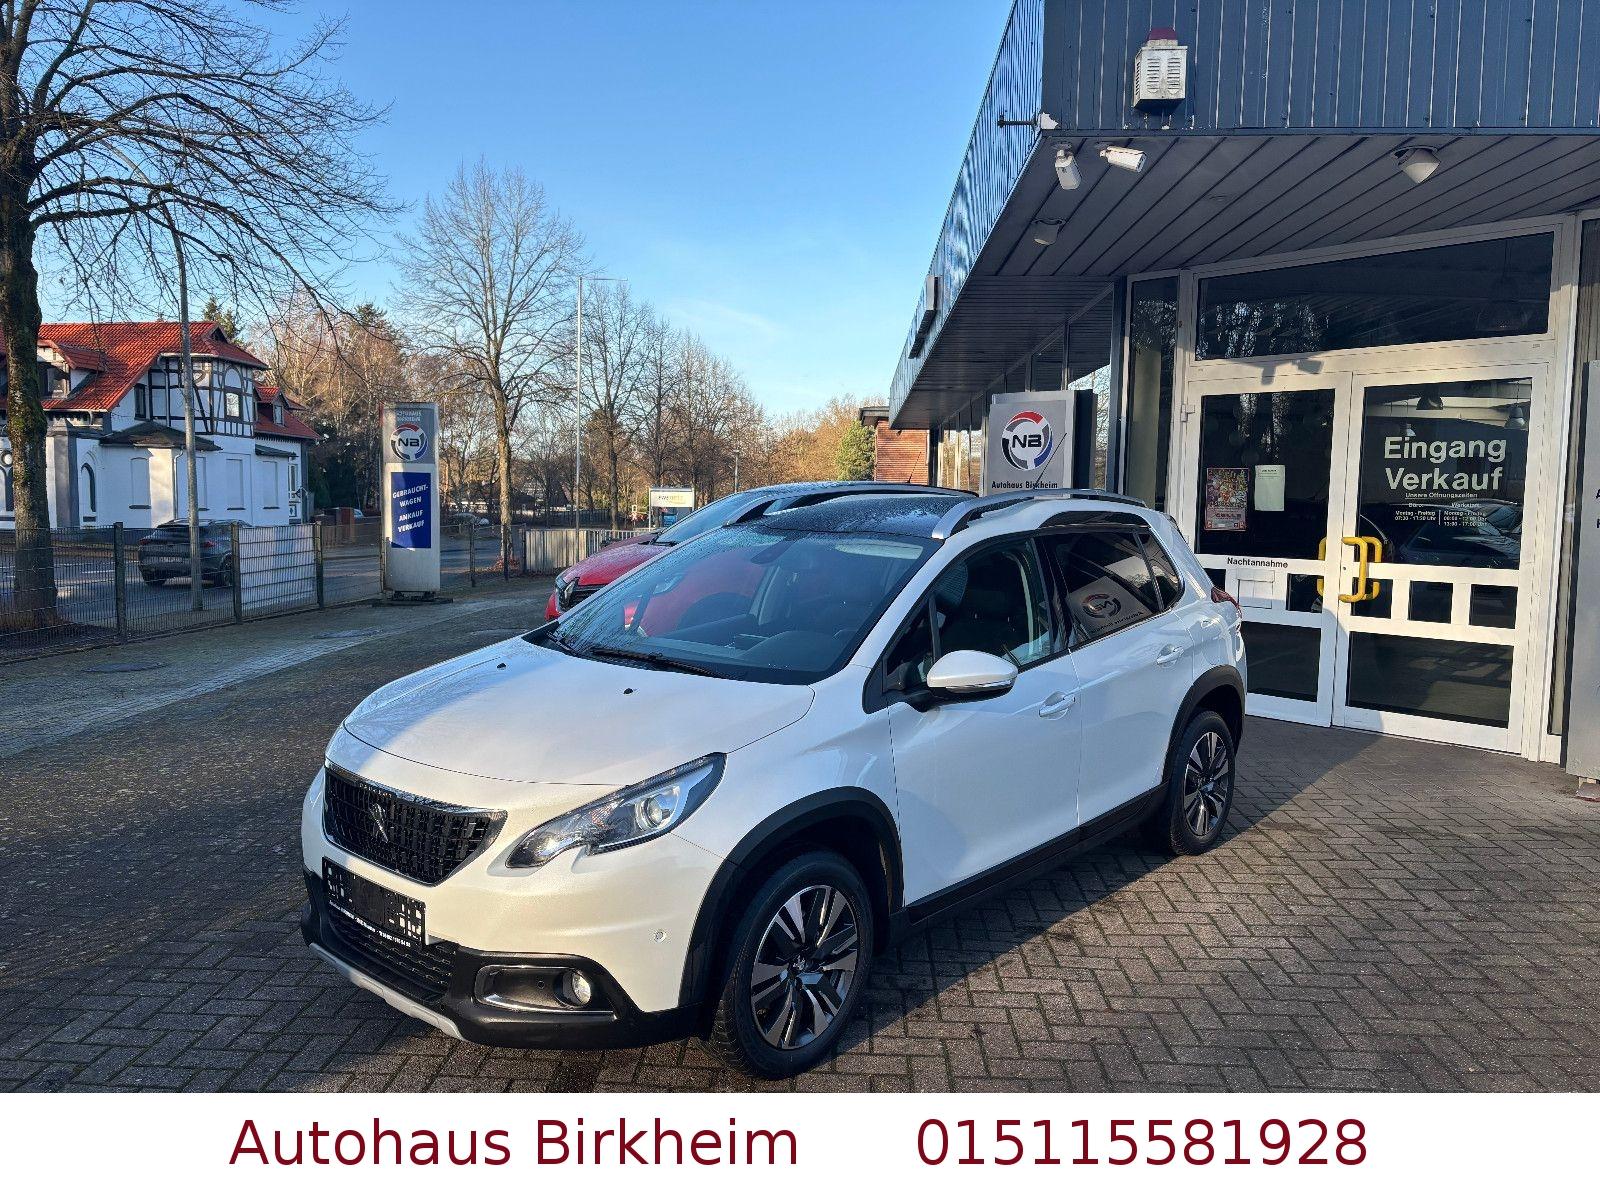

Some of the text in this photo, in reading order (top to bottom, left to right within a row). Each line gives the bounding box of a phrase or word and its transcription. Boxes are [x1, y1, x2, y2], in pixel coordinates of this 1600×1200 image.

[398, 437, 420, 447] NB
[1012, 434, 1042, 448] NB
[1384, 436, 1507, 463] Eingang
[1385, 466, 1503, 490] Verkauf
[991, 480, 1022, 489] Autohaus
[399, 496, 422, 508] WAGEN
[398, 510, 424, 522] ANKAUF
[397, 520, 425, 533] VERKAUF
[1226, 556, 1289, 568] Nachtannahme
